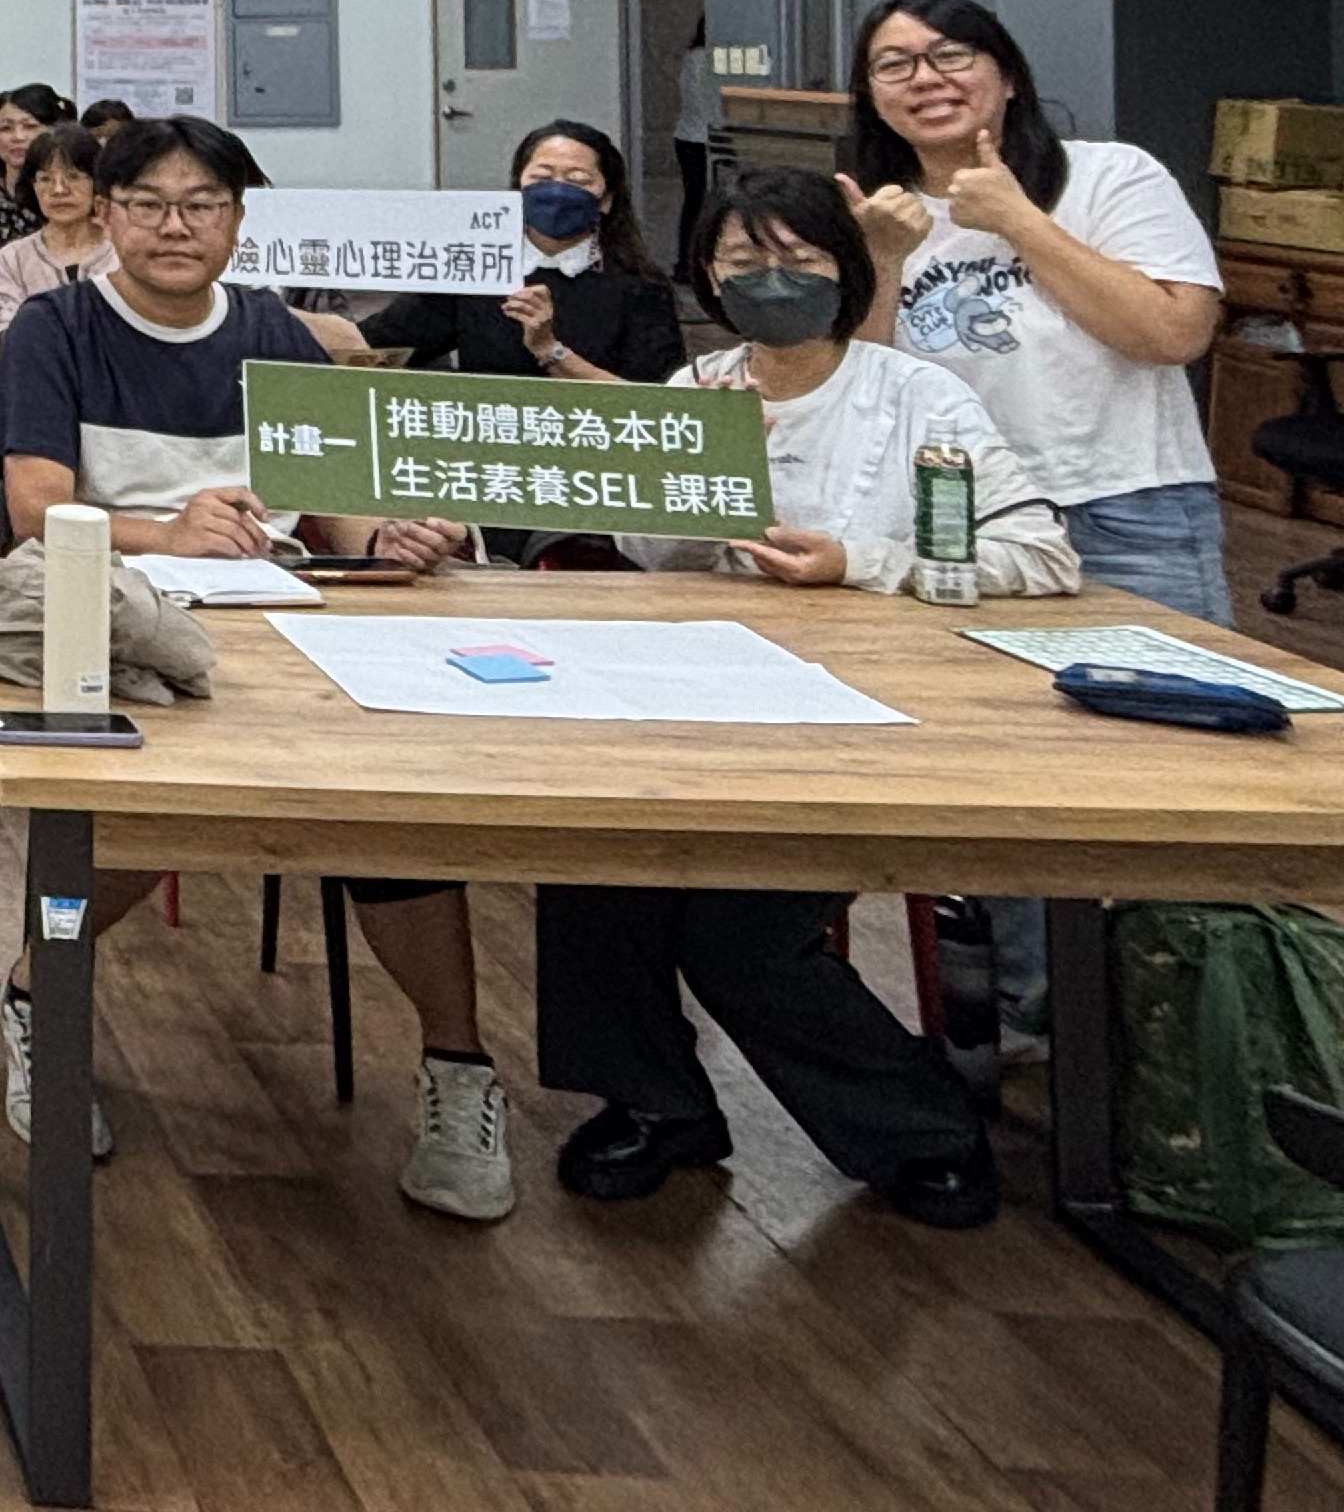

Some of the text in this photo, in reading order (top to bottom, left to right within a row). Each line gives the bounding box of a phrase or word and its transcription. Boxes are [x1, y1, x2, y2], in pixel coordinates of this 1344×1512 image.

[470, 211, 504, 230] ACT
[258, 421, 357, 456] 計畫一
[386, 397, 705, 455] 推動體驗為本的
[390, 457, 759, 518] 生活素養SEL 課程
